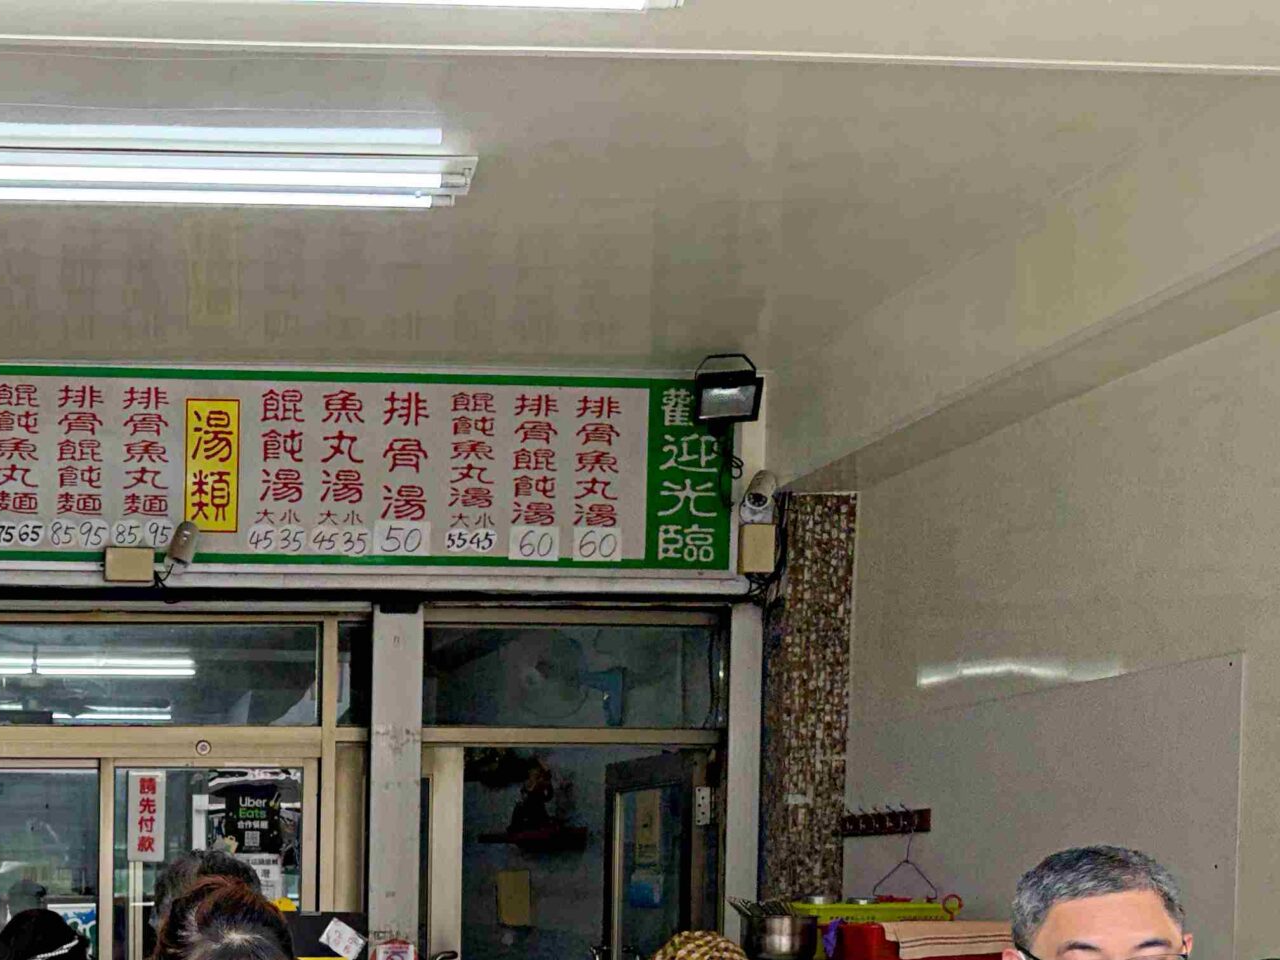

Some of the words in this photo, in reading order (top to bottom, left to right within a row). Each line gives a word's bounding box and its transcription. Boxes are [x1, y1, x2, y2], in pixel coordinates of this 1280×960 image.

[56, 384, 104, 516] 排骨餛飩麵
[123, 386, 170, 517] 排骨魚丸麵
[259, 389, 305, 504] 餛飩湯
[319, 390, 365, 504] 魚丸湯
[380, 391, 429, 522] 排骨湯
[448, 391, 496, 509] 餛飩魚丸湯
[511, 394, 559, 526] 排骨餛飩湯
[191, 409, 234, 522] 湯類
[573, 395, 621, 528] 排骨魚丸湯
[255, 508, 275, 525] 大
[280, 508, 300, 525] 小
[318, 510, 338, 526] 大
[343, 510, 363, 526] 小
[450, 513, 469, 528] 大
[475, 513, 496, 528] 小
[18, 523, 43, 543] 65
[51, 521, 75, 545] 85
[79, 520, 107, 546] 95
[115, 522, 140, 545] 85
[149, 522, 172, 546] 95
[249, 529, 274, 549] 45
[280, 529, 304, 550] 35
[312, 532, 338, 550] 45
[342, 531, 368, 555] 35
[380, 526, 423, 553] 50
[447, 531, 468, 549] 55
[469, 531, 496, 550] 45
[520, 530, 553, 557] 60
[579, 530, 618, 558] 60
[137, 777, 157, 852] 請先付款
[239, 796, 267, 807] Uber
[239, 808, 267, 818] Eats
